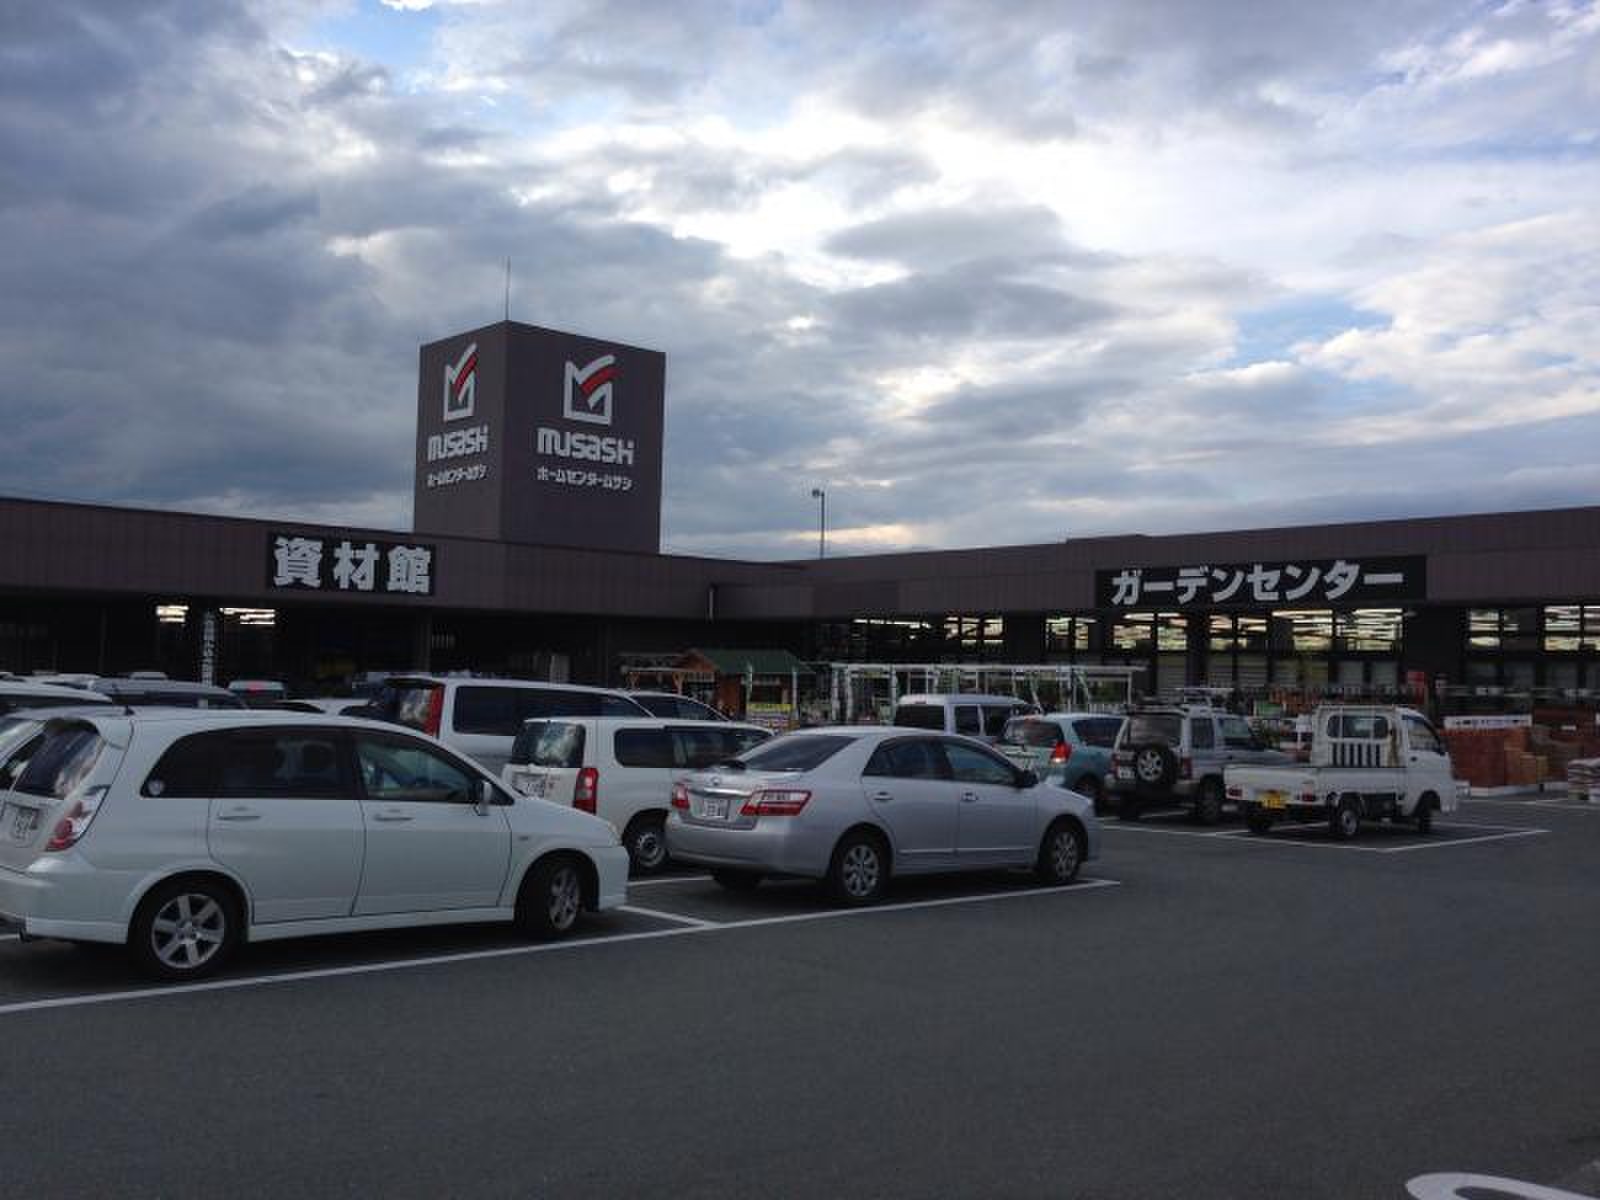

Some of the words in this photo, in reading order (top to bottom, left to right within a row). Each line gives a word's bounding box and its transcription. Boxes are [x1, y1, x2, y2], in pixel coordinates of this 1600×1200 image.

[273, 536, 432, 593] 資材館
[1111, 559, 1404, 605] ガーデンセンター
